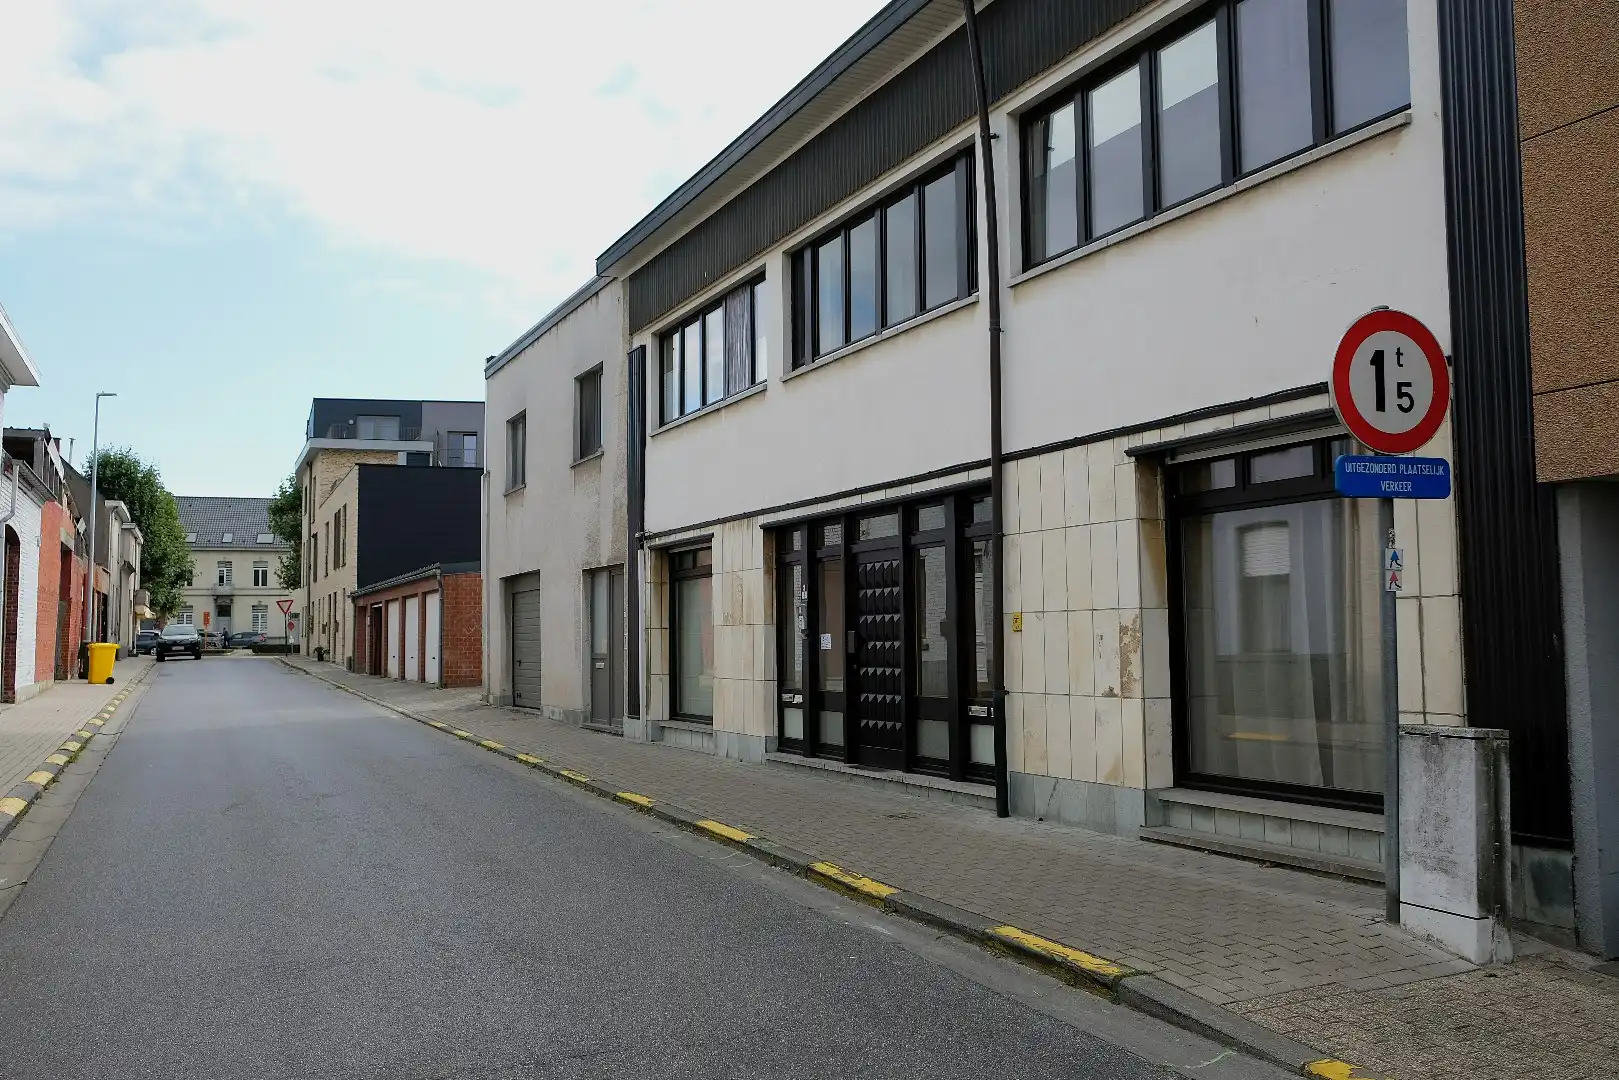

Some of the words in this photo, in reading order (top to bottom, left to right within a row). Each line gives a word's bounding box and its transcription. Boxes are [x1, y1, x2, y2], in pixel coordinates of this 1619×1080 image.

[1395, 347, 1404, 367] t
[1370, 350, 1385, 412] 1
[1397, 381, 1415, 413] 5
[1344, 462, 1397, 474] UITGEZONDERD
[1399, 464, 1445, 476] PLAATSELIJK
[1380, 480, 1412, 492] VERKEER
